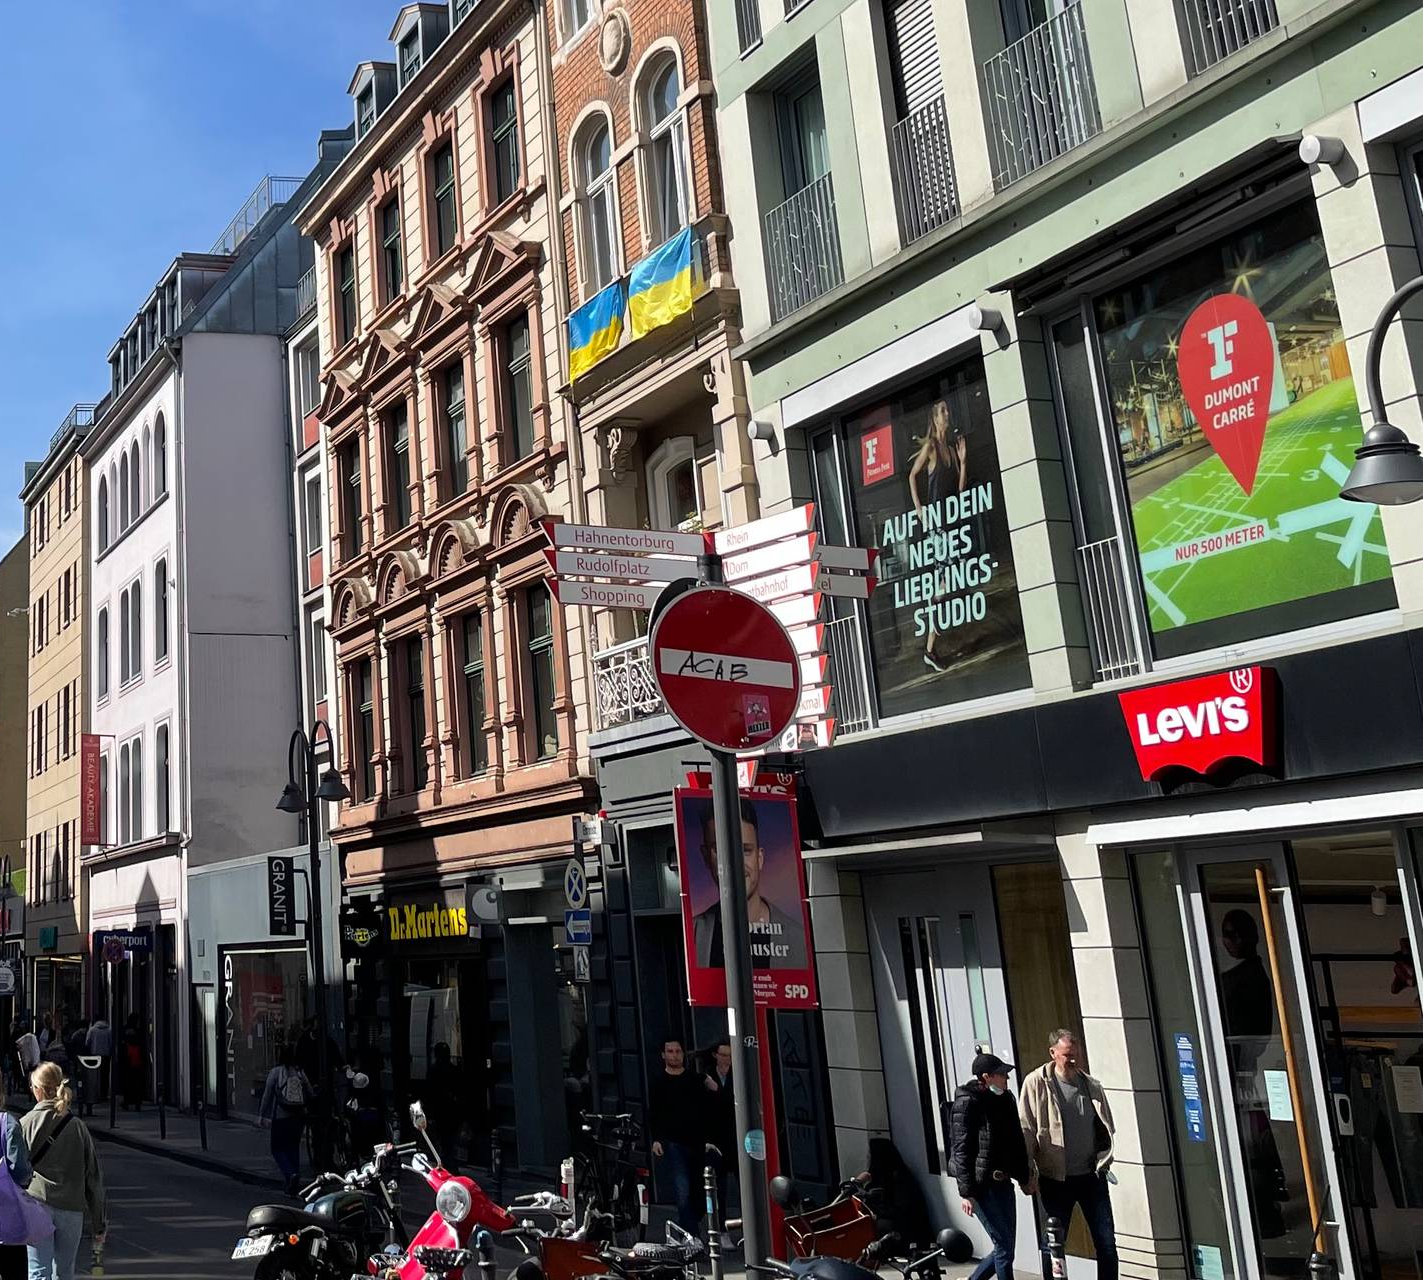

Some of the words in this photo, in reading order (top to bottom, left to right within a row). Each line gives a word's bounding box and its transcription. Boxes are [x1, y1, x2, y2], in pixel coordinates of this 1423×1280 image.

[1204, 376, 1260, 410] DUMONT
[1213, 399, 1255, 429] CARRÉ
[882, 510, 919, 547] AUF
[921, 500, 942, 532] IN
[945, 482, 993, 525] DEIN
[574, 529, 674, 551] Hahnentorburg
[727, 531, 748, 546] Rhein
[910, 525, 972, 571] NEUES
[1175, 543, 1199, 561] NUR
[1201, 537, 1222, 555] 500
[1225, 524, 1265, 548] METER
[576, 558, 650, 576] Rudolfplatz
[729, 560, 748, 574] Dom
[894, 553, 999, 609] LIEBLINGS-
[581, 586, 645, 607] Shopping
[913, 591, 986, 637] STUDIO
[678, 650, 748, 682] ACAB
[271, 859, 287, 924] GRANIT
[784, 984, 809, 999] SPD
